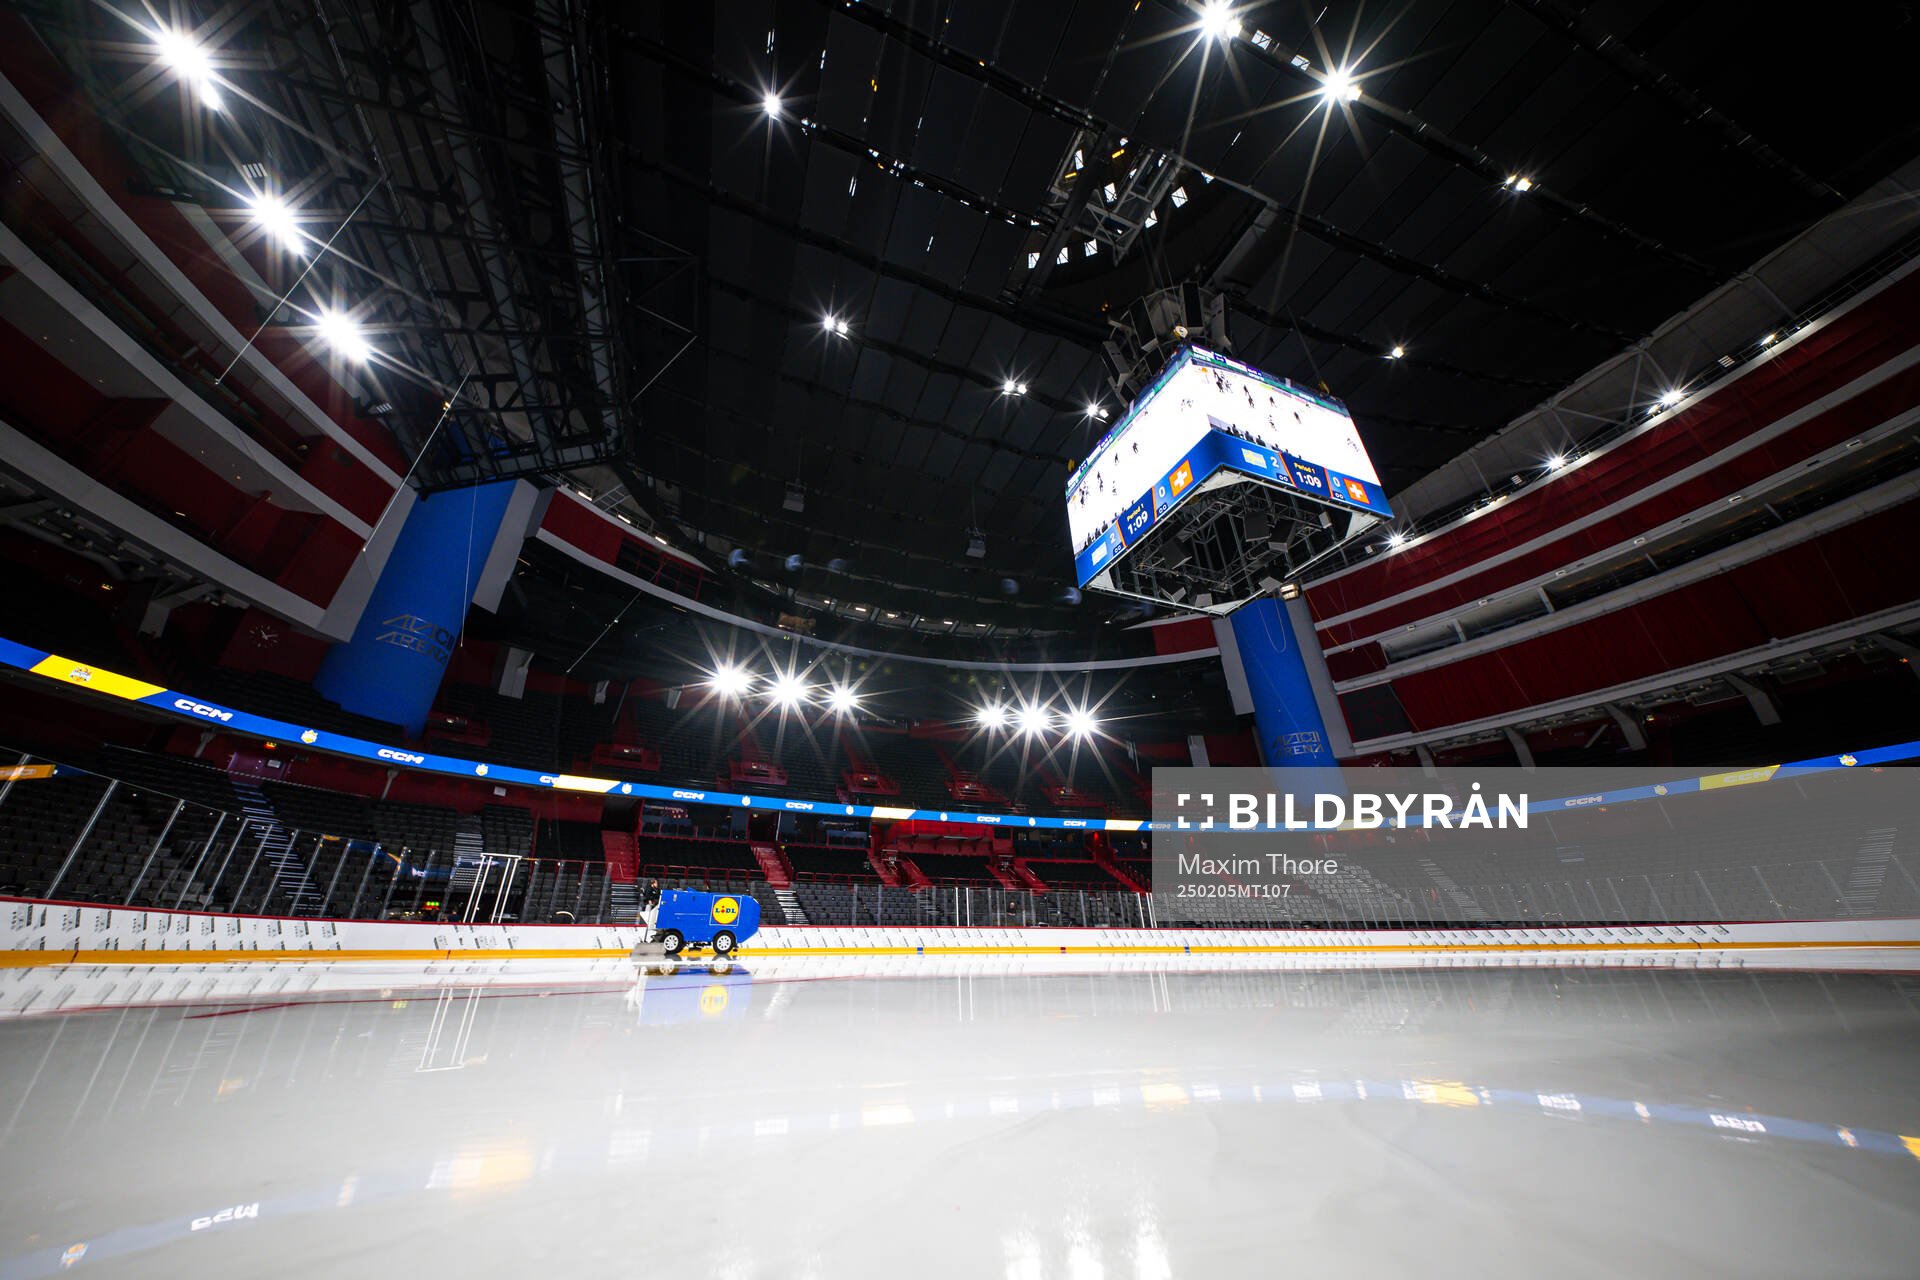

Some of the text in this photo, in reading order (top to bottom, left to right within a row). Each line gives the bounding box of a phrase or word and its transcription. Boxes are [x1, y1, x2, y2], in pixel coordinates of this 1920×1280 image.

[1270, 456, 1280, 468] 2
[1294, 462, 1311, 472] Period
[1296, 471, 1322, 488] 1:09
[1332, 477, 1340, 487] 0
[1158, 486, 1166, 498] 0
[1127, 510, 1149, 535] 1:09
[1109, 533, 1115, 543] 2
[174, 698, 234, 722] CCM
[377, 748, 425, 764] CCM
[1723, 770, 1771, 783] CCM
[672, 790, 705, 800] CCM
[1564, 795, 1603, 806] CCM
[785, 801, 813, 810] CCM
